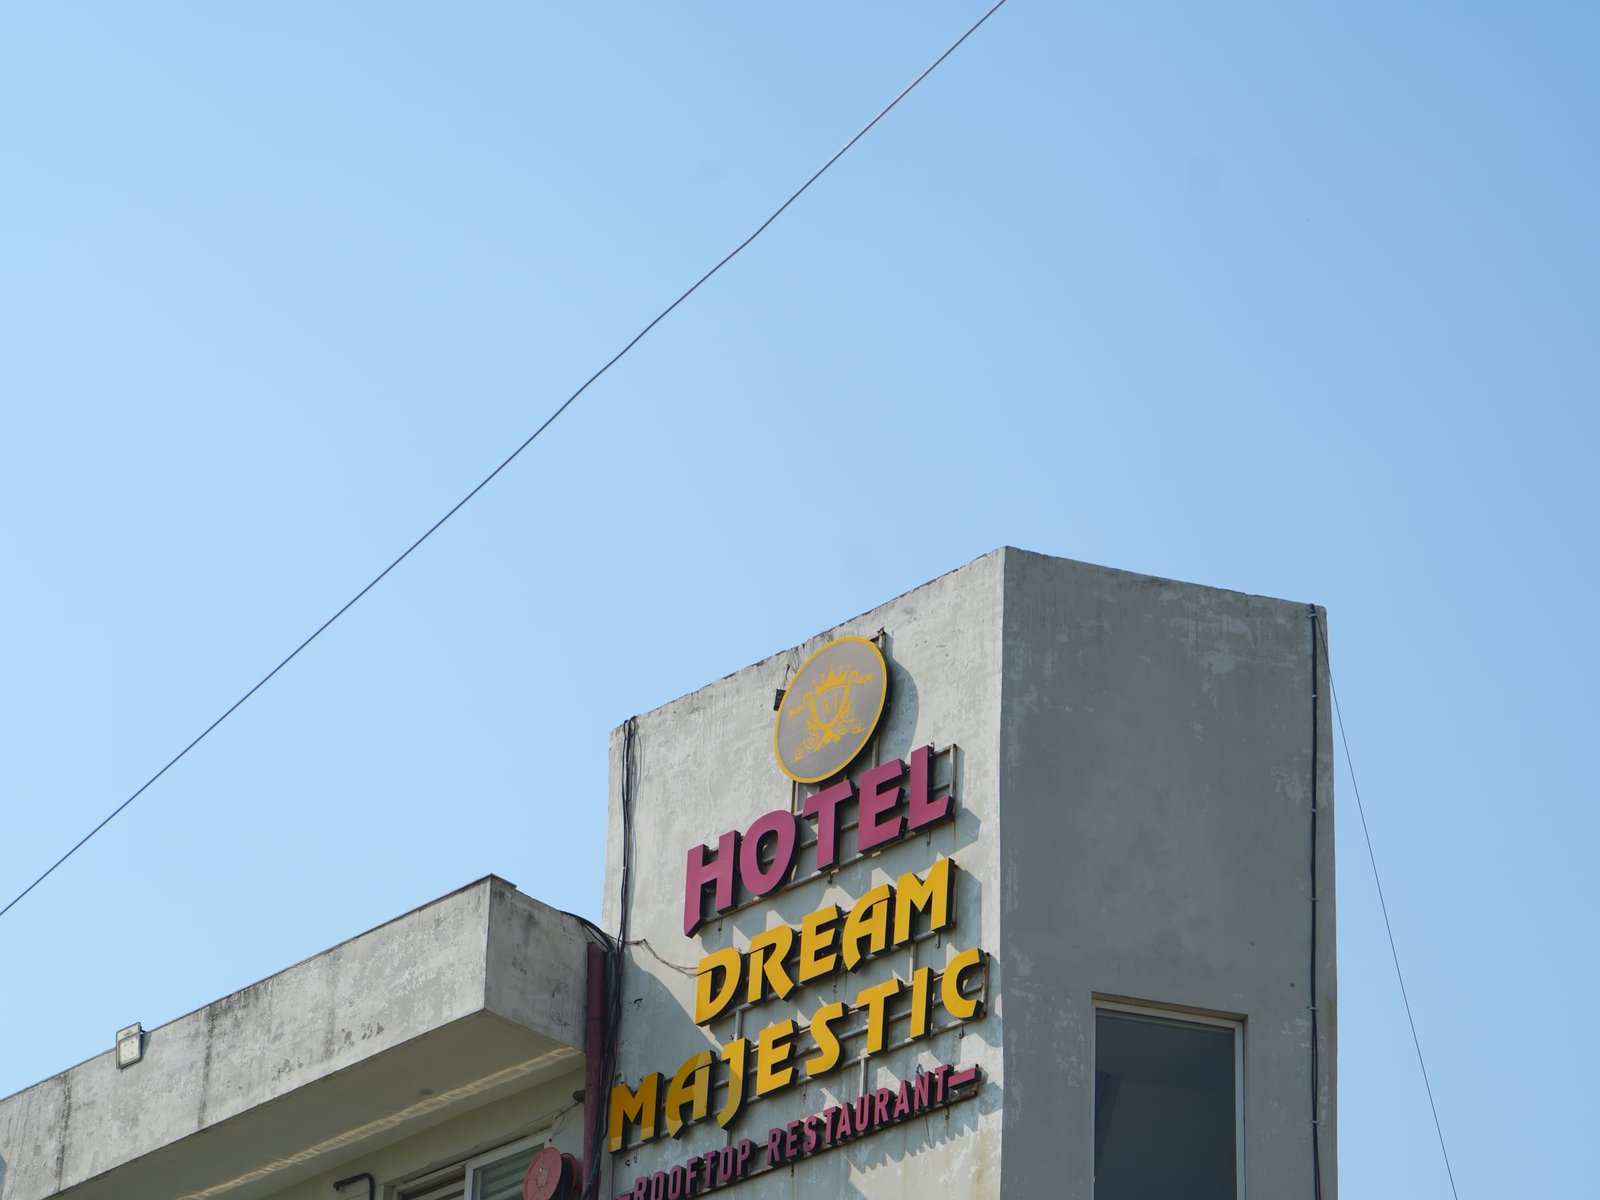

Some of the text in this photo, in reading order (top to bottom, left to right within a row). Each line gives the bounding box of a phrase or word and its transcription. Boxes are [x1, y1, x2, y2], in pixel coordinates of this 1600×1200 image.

[684, 745, 953, 937] HOTEL
[695, 857, 954, 1027] DREAM
[608, 948, 985, 1153] MAJESTIC
